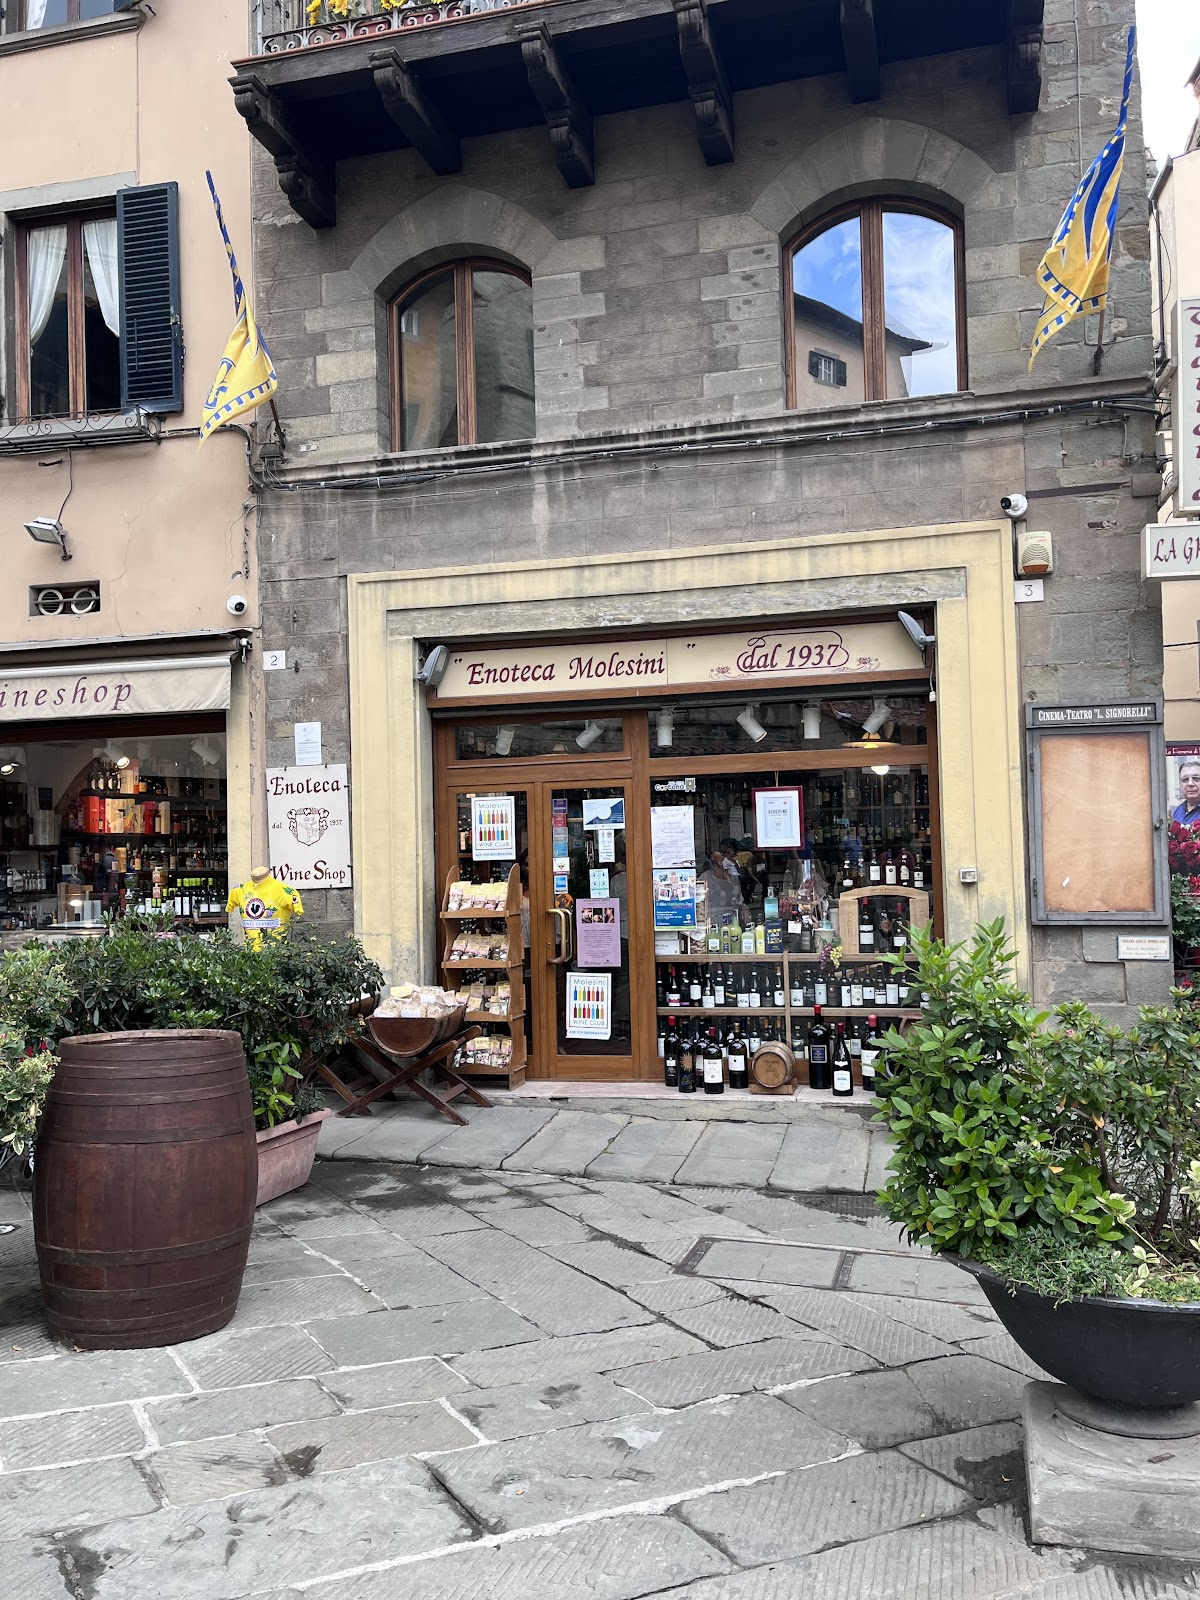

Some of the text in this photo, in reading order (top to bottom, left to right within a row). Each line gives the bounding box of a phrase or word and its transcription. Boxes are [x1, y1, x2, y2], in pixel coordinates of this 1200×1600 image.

[1154, 538, 1177, 562] LA
[1024, 584, 1033, 596] 3
[270, 655, 278, 666] 2
[568, 650, 665, 679] Molesini
[741, 643, 840, 670] dal 1937
[1038, 709, 1093, 722] CINEMA-TEATRO
[1105, 706, 1152, 719] SIGNORELLI"
[270, 776, 341, 796] Enoteca
[271, 859, 346, 884] Wine Shop
